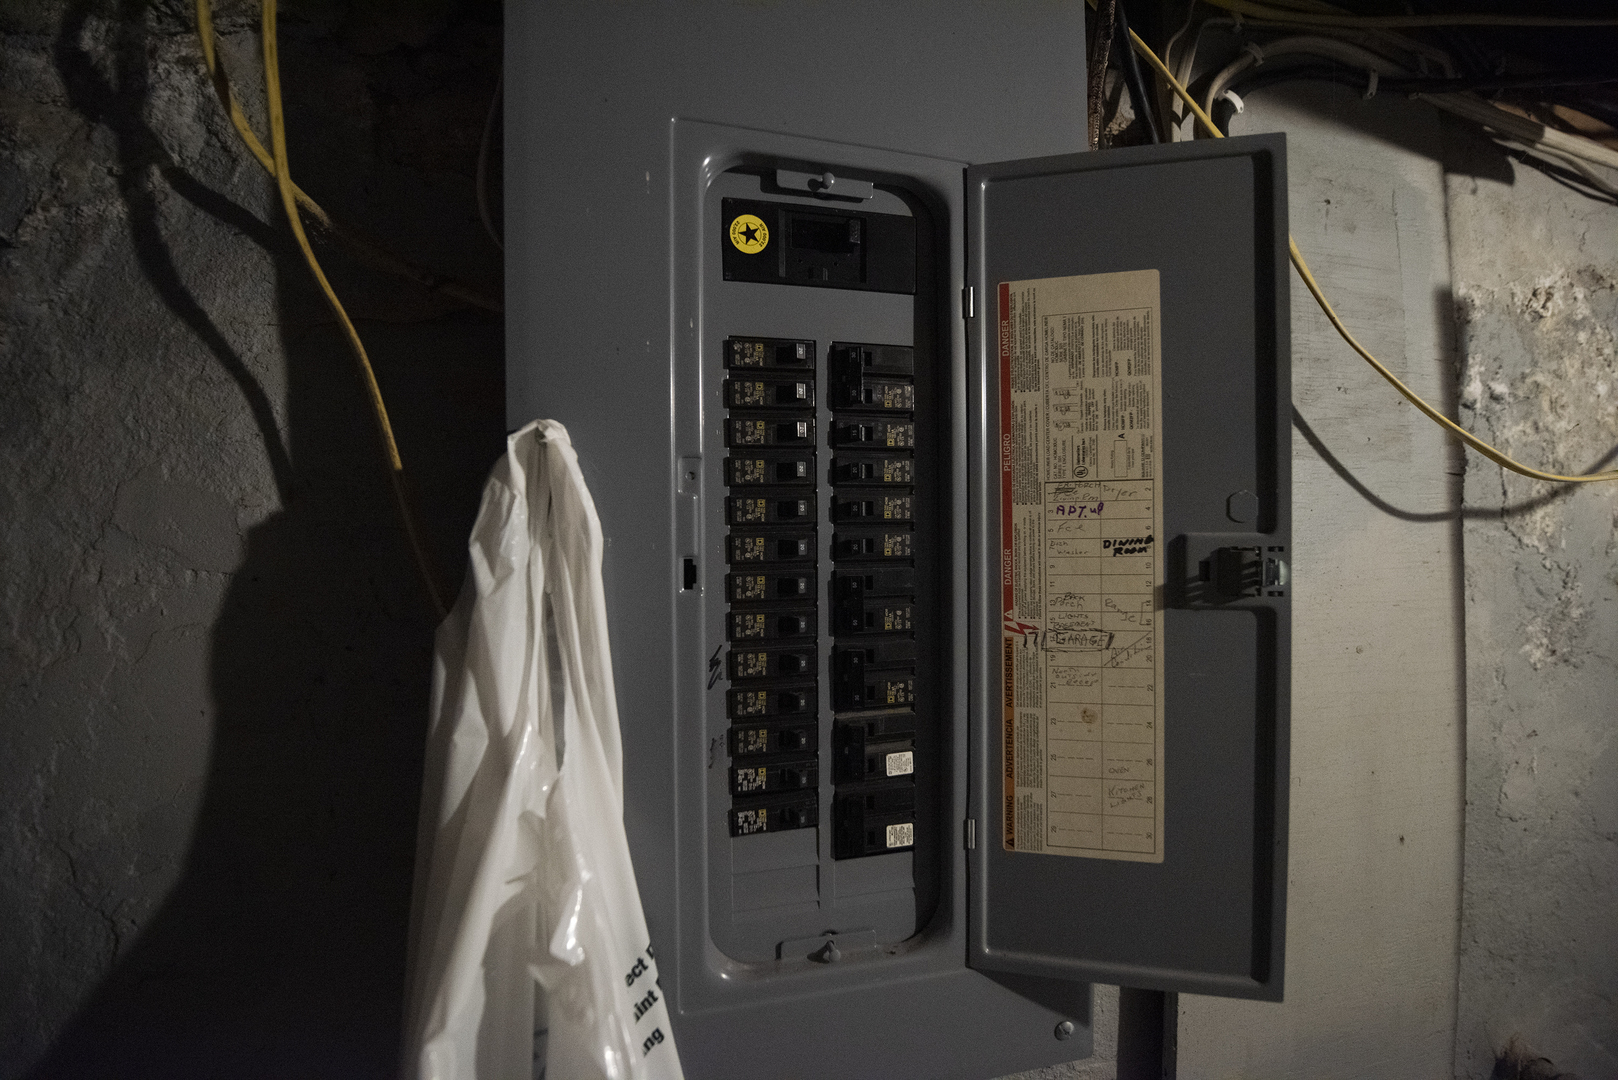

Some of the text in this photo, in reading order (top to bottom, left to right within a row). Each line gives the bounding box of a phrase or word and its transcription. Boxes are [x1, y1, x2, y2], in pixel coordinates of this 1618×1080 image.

[1056, 505, 1087, 518] APT.
[1103, 535, 1154, 549] DINING
[1113, 546, 1147, 557] ROOM
[1056, 632, 1107, 646] GARAGE
[642, 1028, 664, 1058] ng
